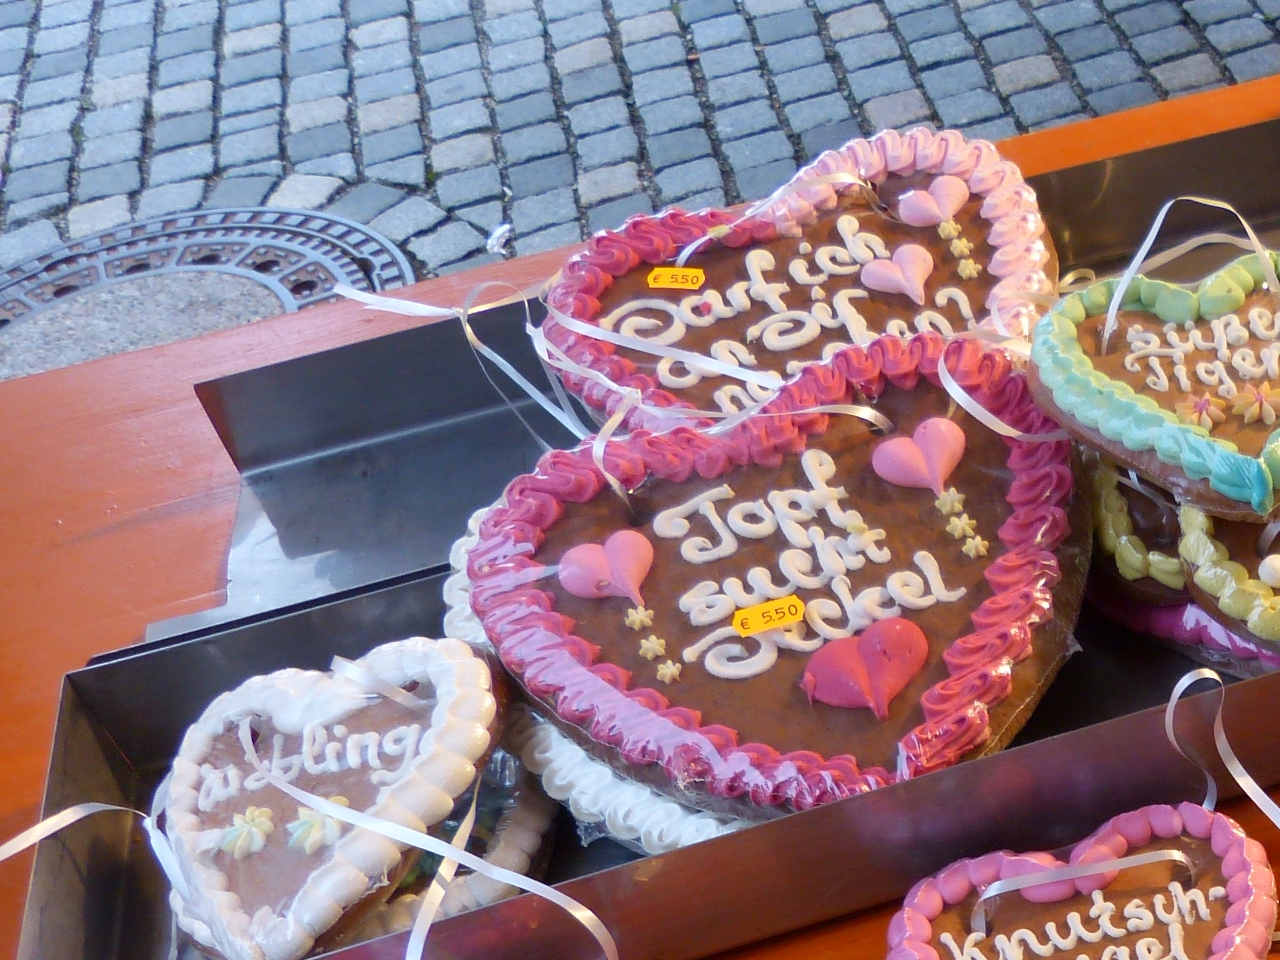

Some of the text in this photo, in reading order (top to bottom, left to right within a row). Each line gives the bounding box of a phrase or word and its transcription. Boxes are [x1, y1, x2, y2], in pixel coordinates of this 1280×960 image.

[600, 214, 891, 346] Darf ich
[652, 273, 700, 285] € 5.50
[652, 449, 852, 566] Topf
[678, 525, 893, 627] sucht
[739, 603, 799, 631] € 5.50
